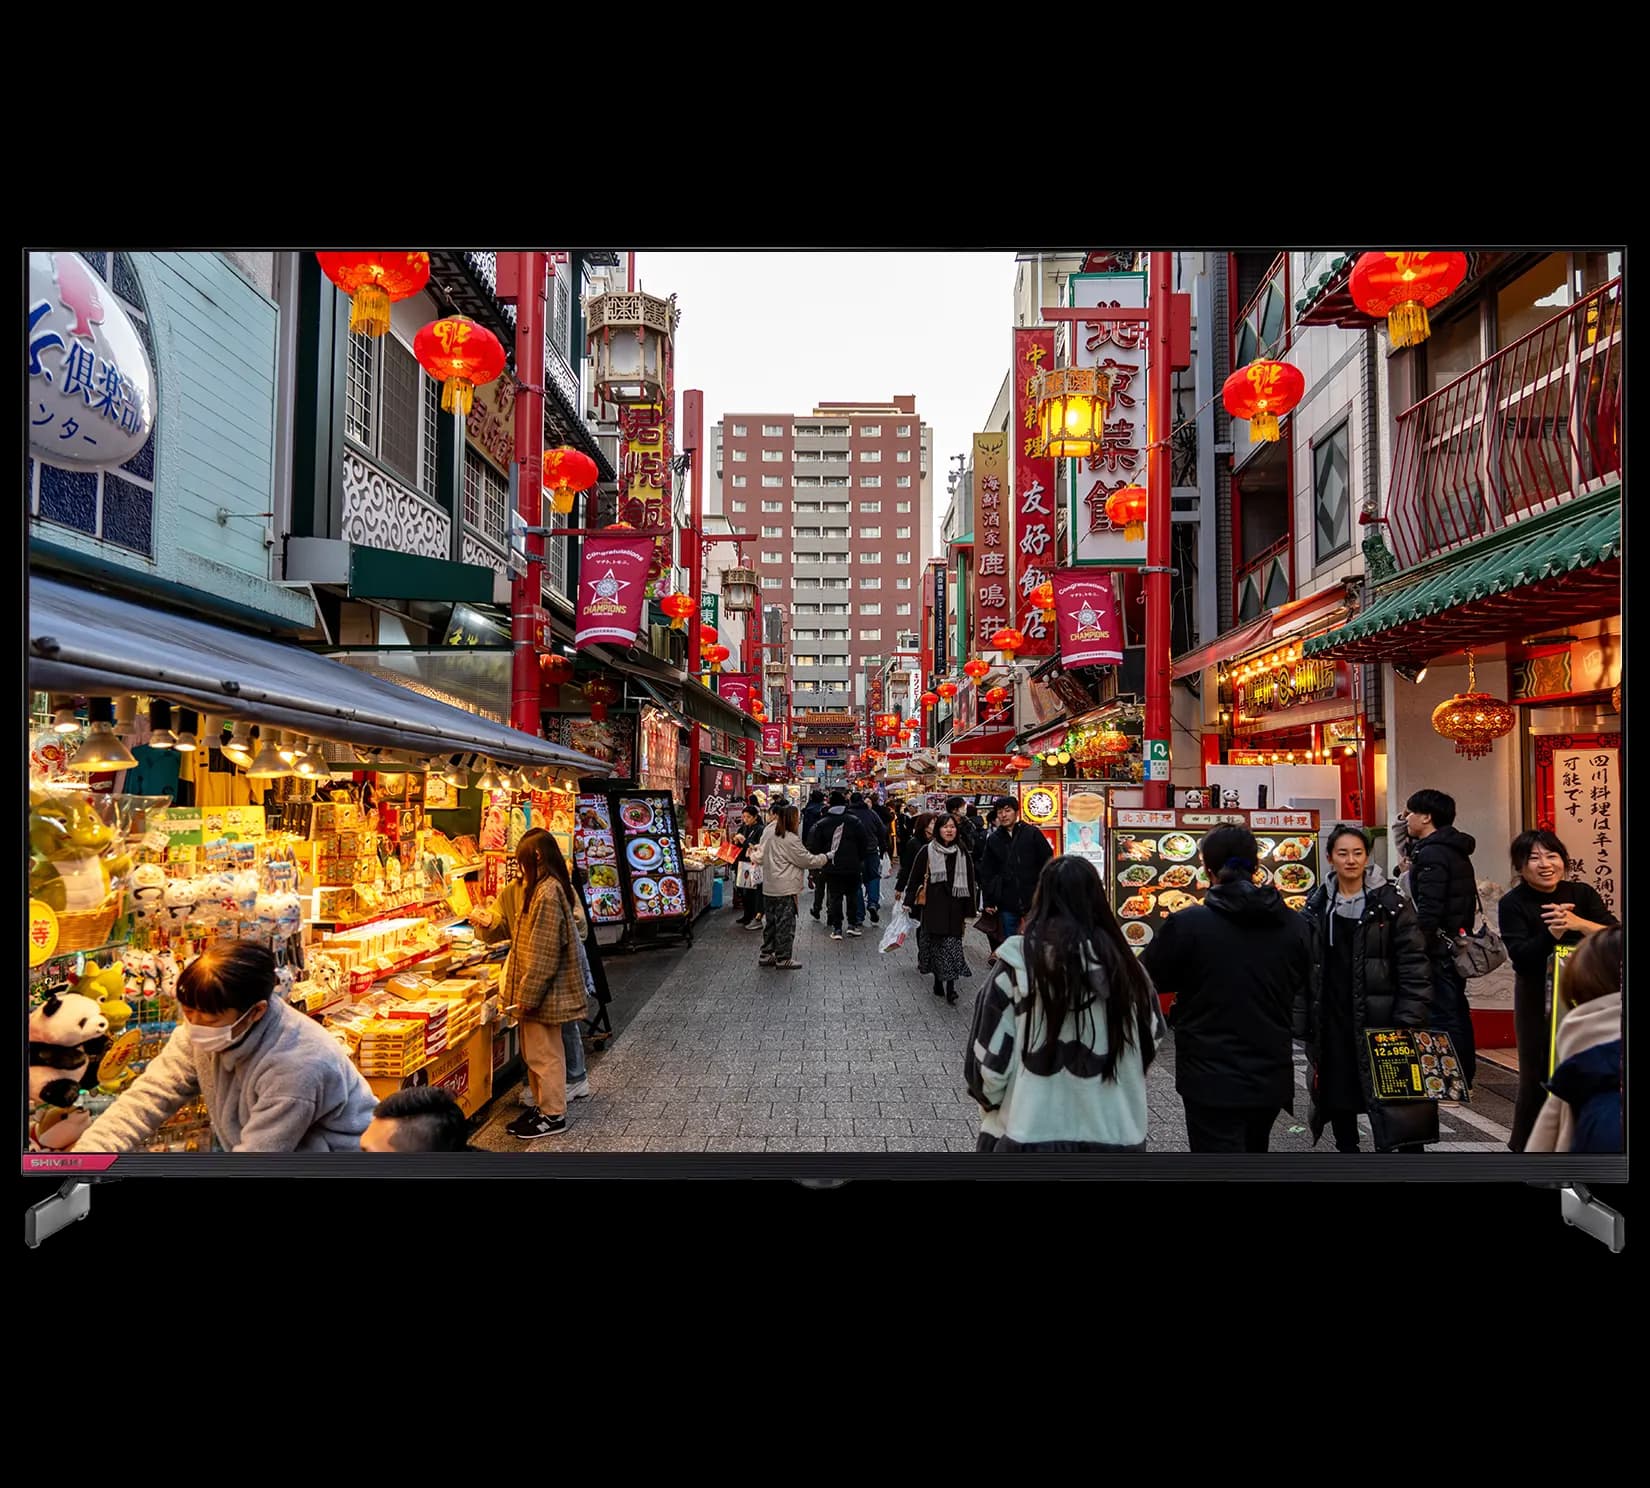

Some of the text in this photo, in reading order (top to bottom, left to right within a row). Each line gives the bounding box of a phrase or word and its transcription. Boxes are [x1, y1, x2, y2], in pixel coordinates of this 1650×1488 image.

[982, 475, 1001, 547] 海鮮酒家
[583, 604, 627, 616] CHAMPIONS
[1070, 631, 1110, 641] CHAMPIONS
[1562, 757, 1583, 823] 可能です。
[1121, 813, 1174, 824] 北京料理
[1255, 815, 1308, 826] 四川料理
